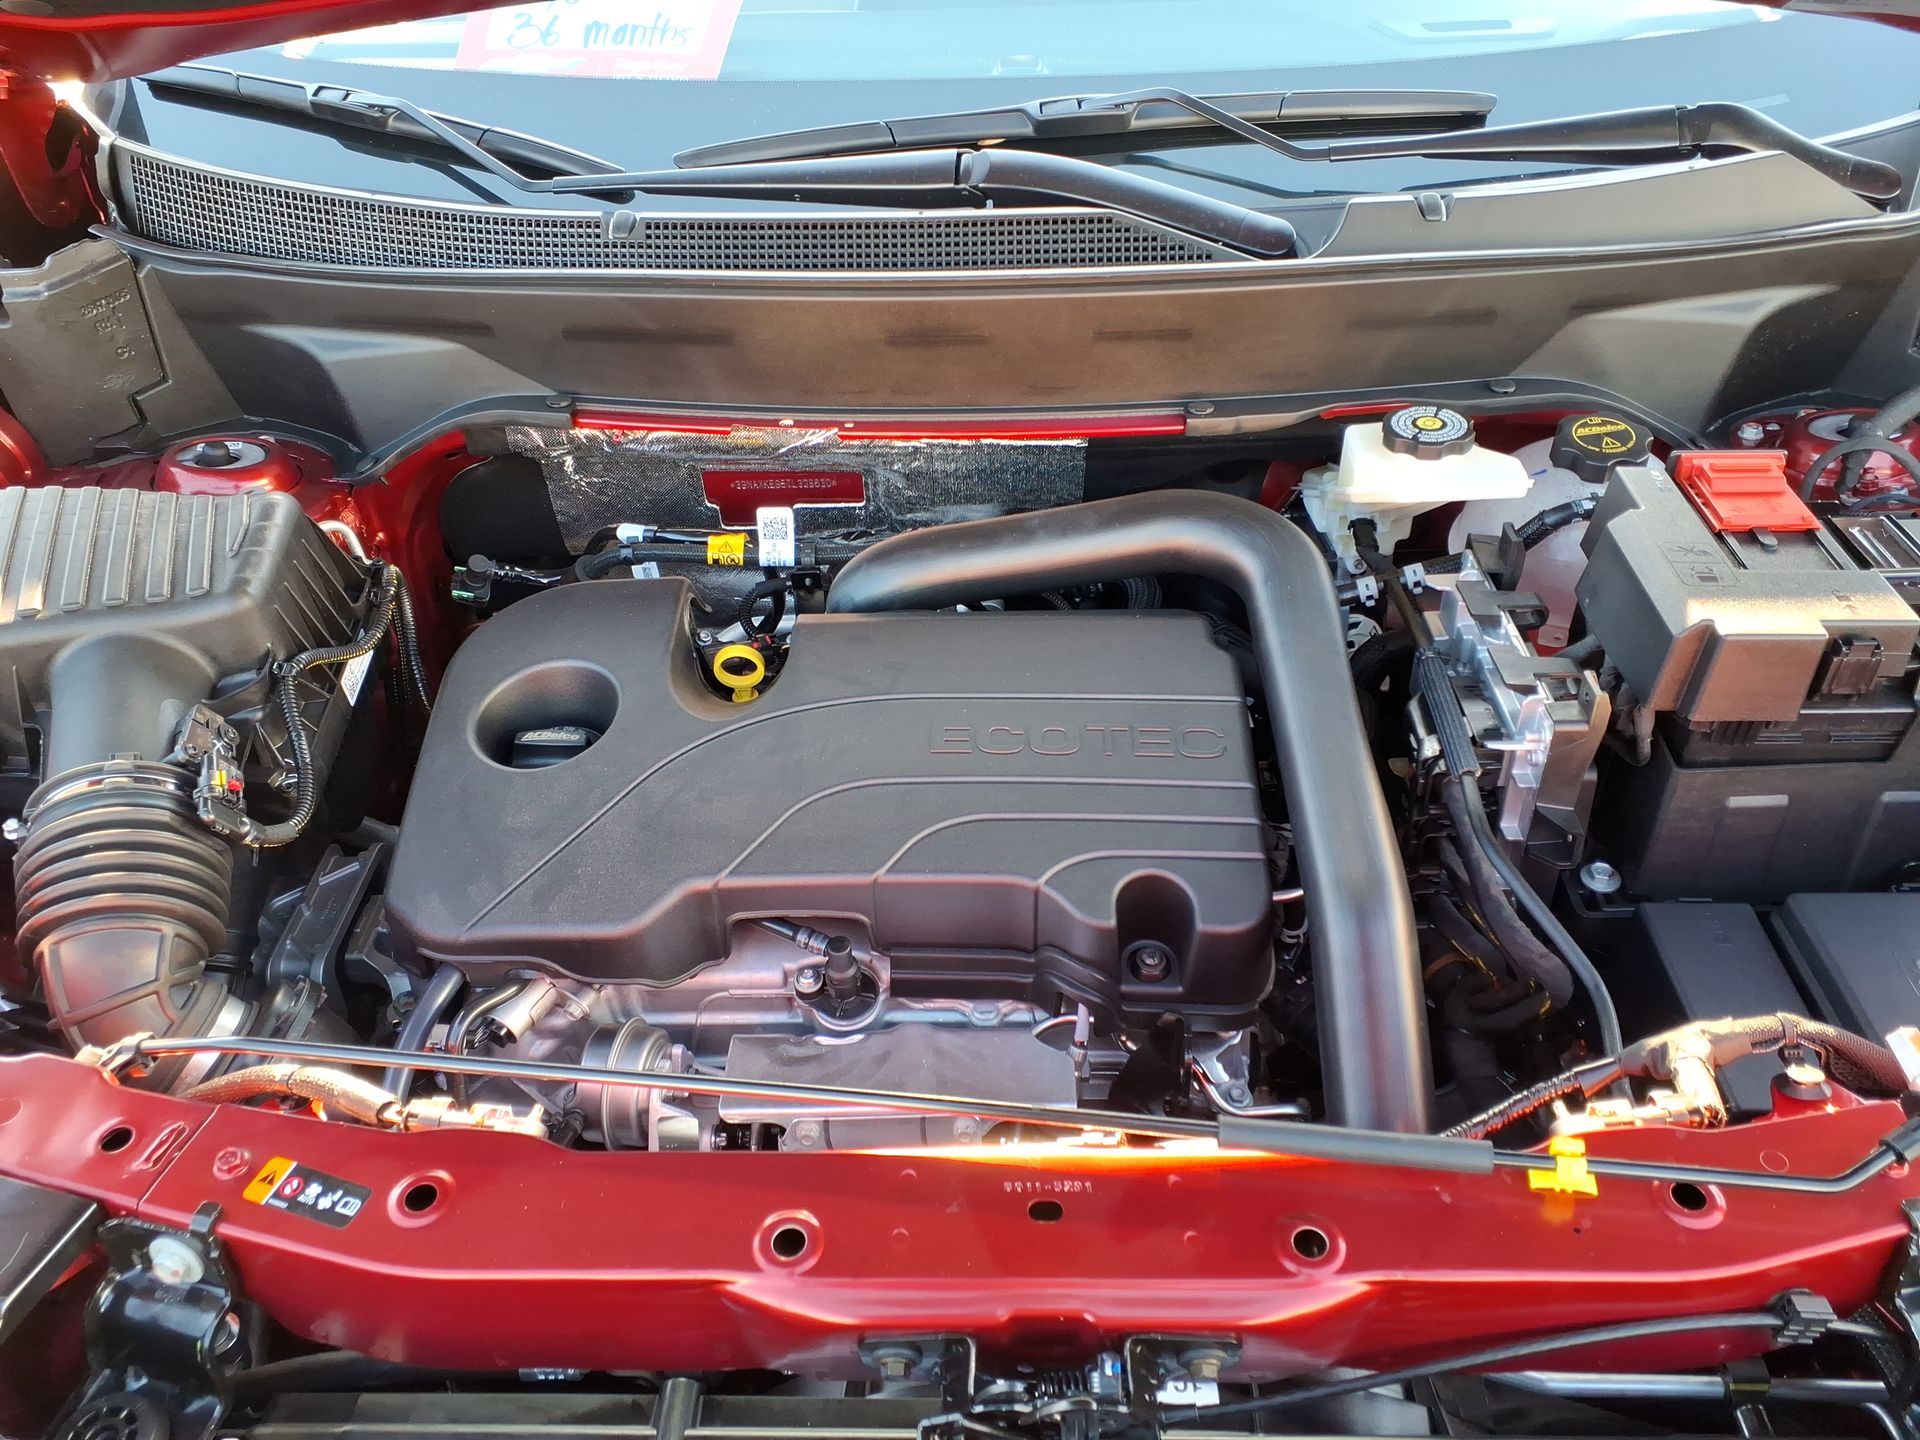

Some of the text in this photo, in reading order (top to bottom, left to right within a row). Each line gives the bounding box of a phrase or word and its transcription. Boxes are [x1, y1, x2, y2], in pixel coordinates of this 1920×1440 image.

[507, 13, 694, 49] 36 months
[1576, 424, 1626, 436] ACDelco
[521, 731, 580, 741] ACDelco
[929, 722, 1228, 759] ECOTEC
[297, 1193, 315, 1205] AUTO
